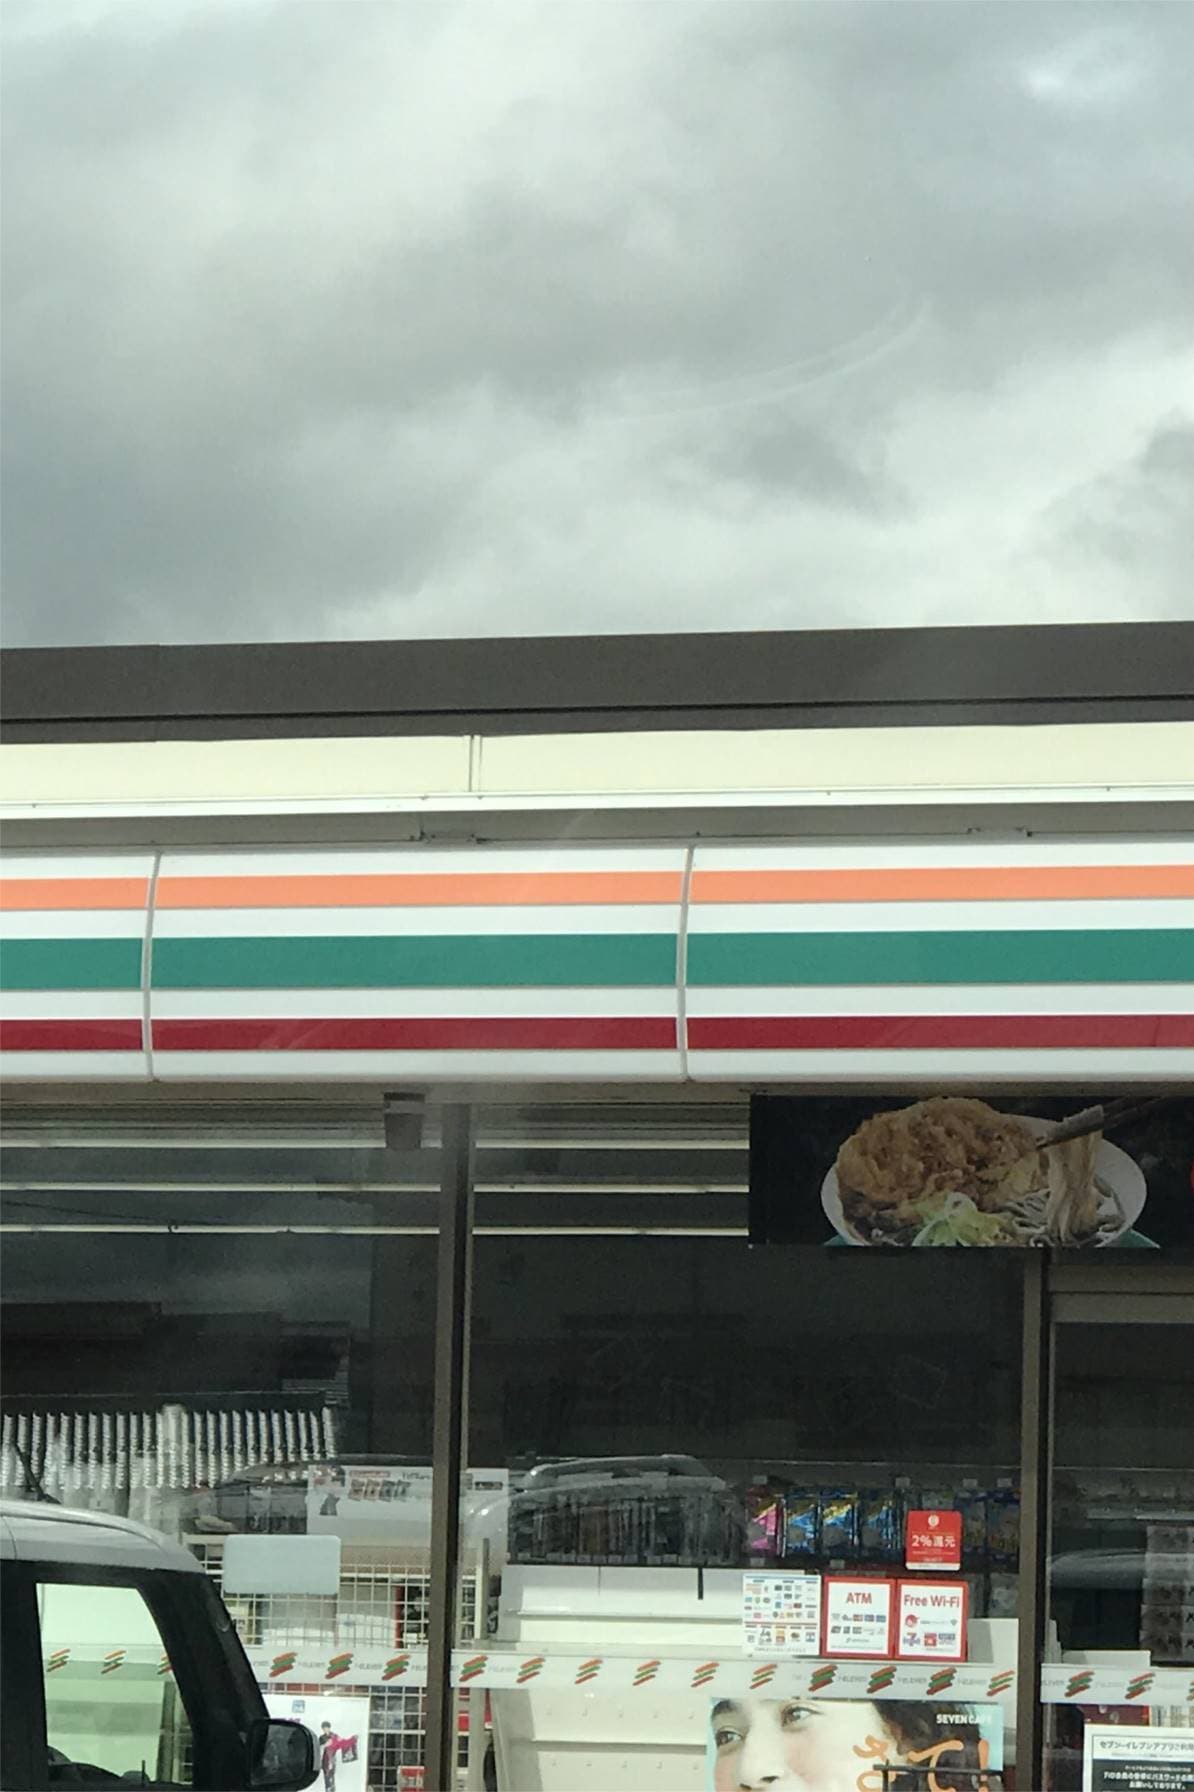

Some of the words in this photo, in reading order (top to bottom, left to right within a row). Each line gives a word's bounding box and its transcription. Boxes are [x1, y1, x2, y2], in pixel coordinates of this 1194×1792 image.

[846, 1592, 872, 1605] ATM
[904, 1594, 928, 1607] Free
[930, 1595, 960, 1608] Wi-Fi
[936, 1713, 968, 1725] SEVEN
